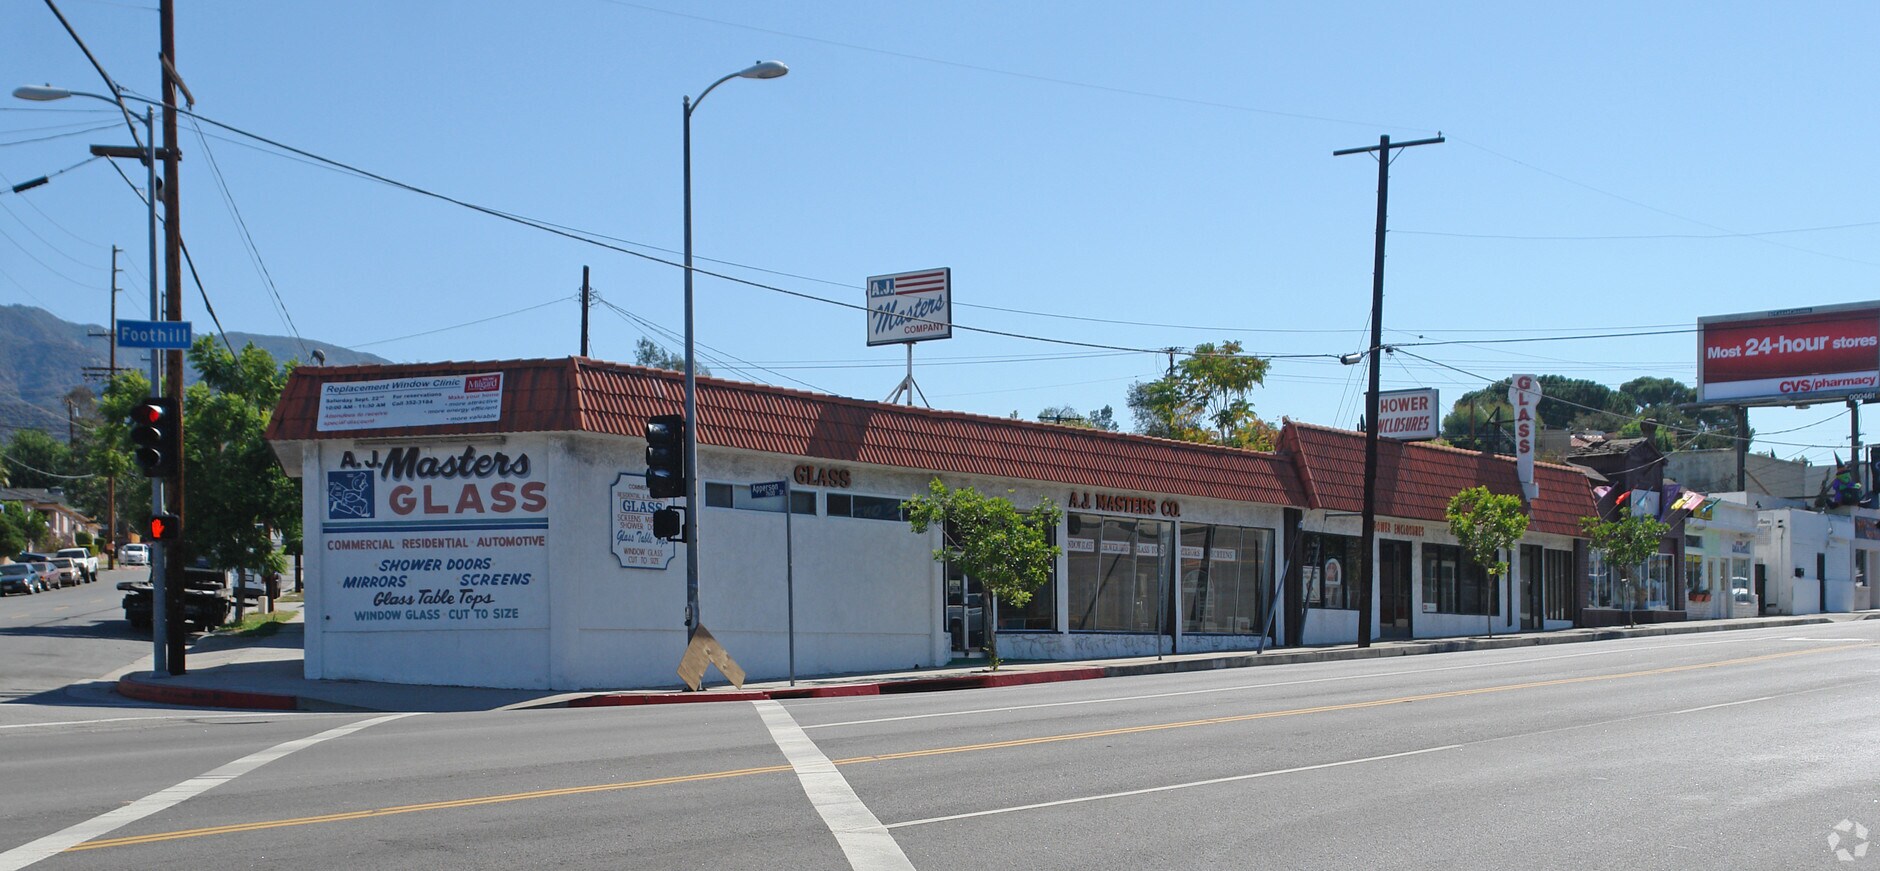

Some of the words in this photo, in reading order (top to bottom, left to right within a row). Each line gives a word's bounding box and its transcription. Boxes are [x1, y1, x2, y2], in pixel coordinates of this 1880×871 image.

[871, 281, 894, 296] A.J.
[873, 294, 945, 335] Masters
[121, 326, 187, 342] Foothill
[904, 323, 944, 334] COMPANY
[1707, 345, 1741, 359] Most
[1745, 335, 1829, 356] 24-hour
[1832, 336, 1877, 349] stores
[326, 383, 390, 395] Replacement
[392, 380, 430, 389] Window
[433, 379, 460, 387] Clinic
[468, 378, 497, 390] Milgard
[1779, 376, 1876, 393] CVS/pharmacy
[1380, 396, 1428, 413] HOWER
[1518, 376, 1532, 453] GLASS
[1378, 416, 1429, 433] NCLOSURES
[340, 450, 382, 469] A.J.
[381, 445, 531, 481] Masters
[794, 464, 852, 488] GLASS
[752, 483, 778, 494] Apperson
[389, 482, 547, 515] GLASS
[1095, 493, 1156, 515] MASTERS
[1161, 499, 1181, 517] CO.
[622, 500, 662, 513] GLASS
[617, 514, 641, 522] SCREENS
[620, 522, 643, 530] SHOWER
[327, 539, 394, 550] COMMERCIAL
[402, 538, 468, 549] RESIDENTIAL
[476, 536, 545, 547] AUTOMOTIVE
[617, 530, 634, 545] Glass
[636, 531, 653, 544] Table
[623, 547, 645, 555] WINDOW
[647, 549, 663, 557] GLASS
[379, 559, 442, 572] SHOWER
[446, 557, 492, 570] DOORS
[628, 556, 637, 564] CUT
[650, 557, 659, 565] SIZE
[343, 575, 407, 588] MIRRORS
[459, 573, 531, 586] SCREENS
[373, 592, 415, 606] Glass
[418, 589, 455, 605] Table
[459, 589, 495, 609] Tops
[354, 610, 401, 621] WINDOW
[405, 610, 440, 620] GLASS
[448, 609, 470, 620] CUT
[474, 608, 489, 619] TO
[493, 608, 519, 619] SIZE
